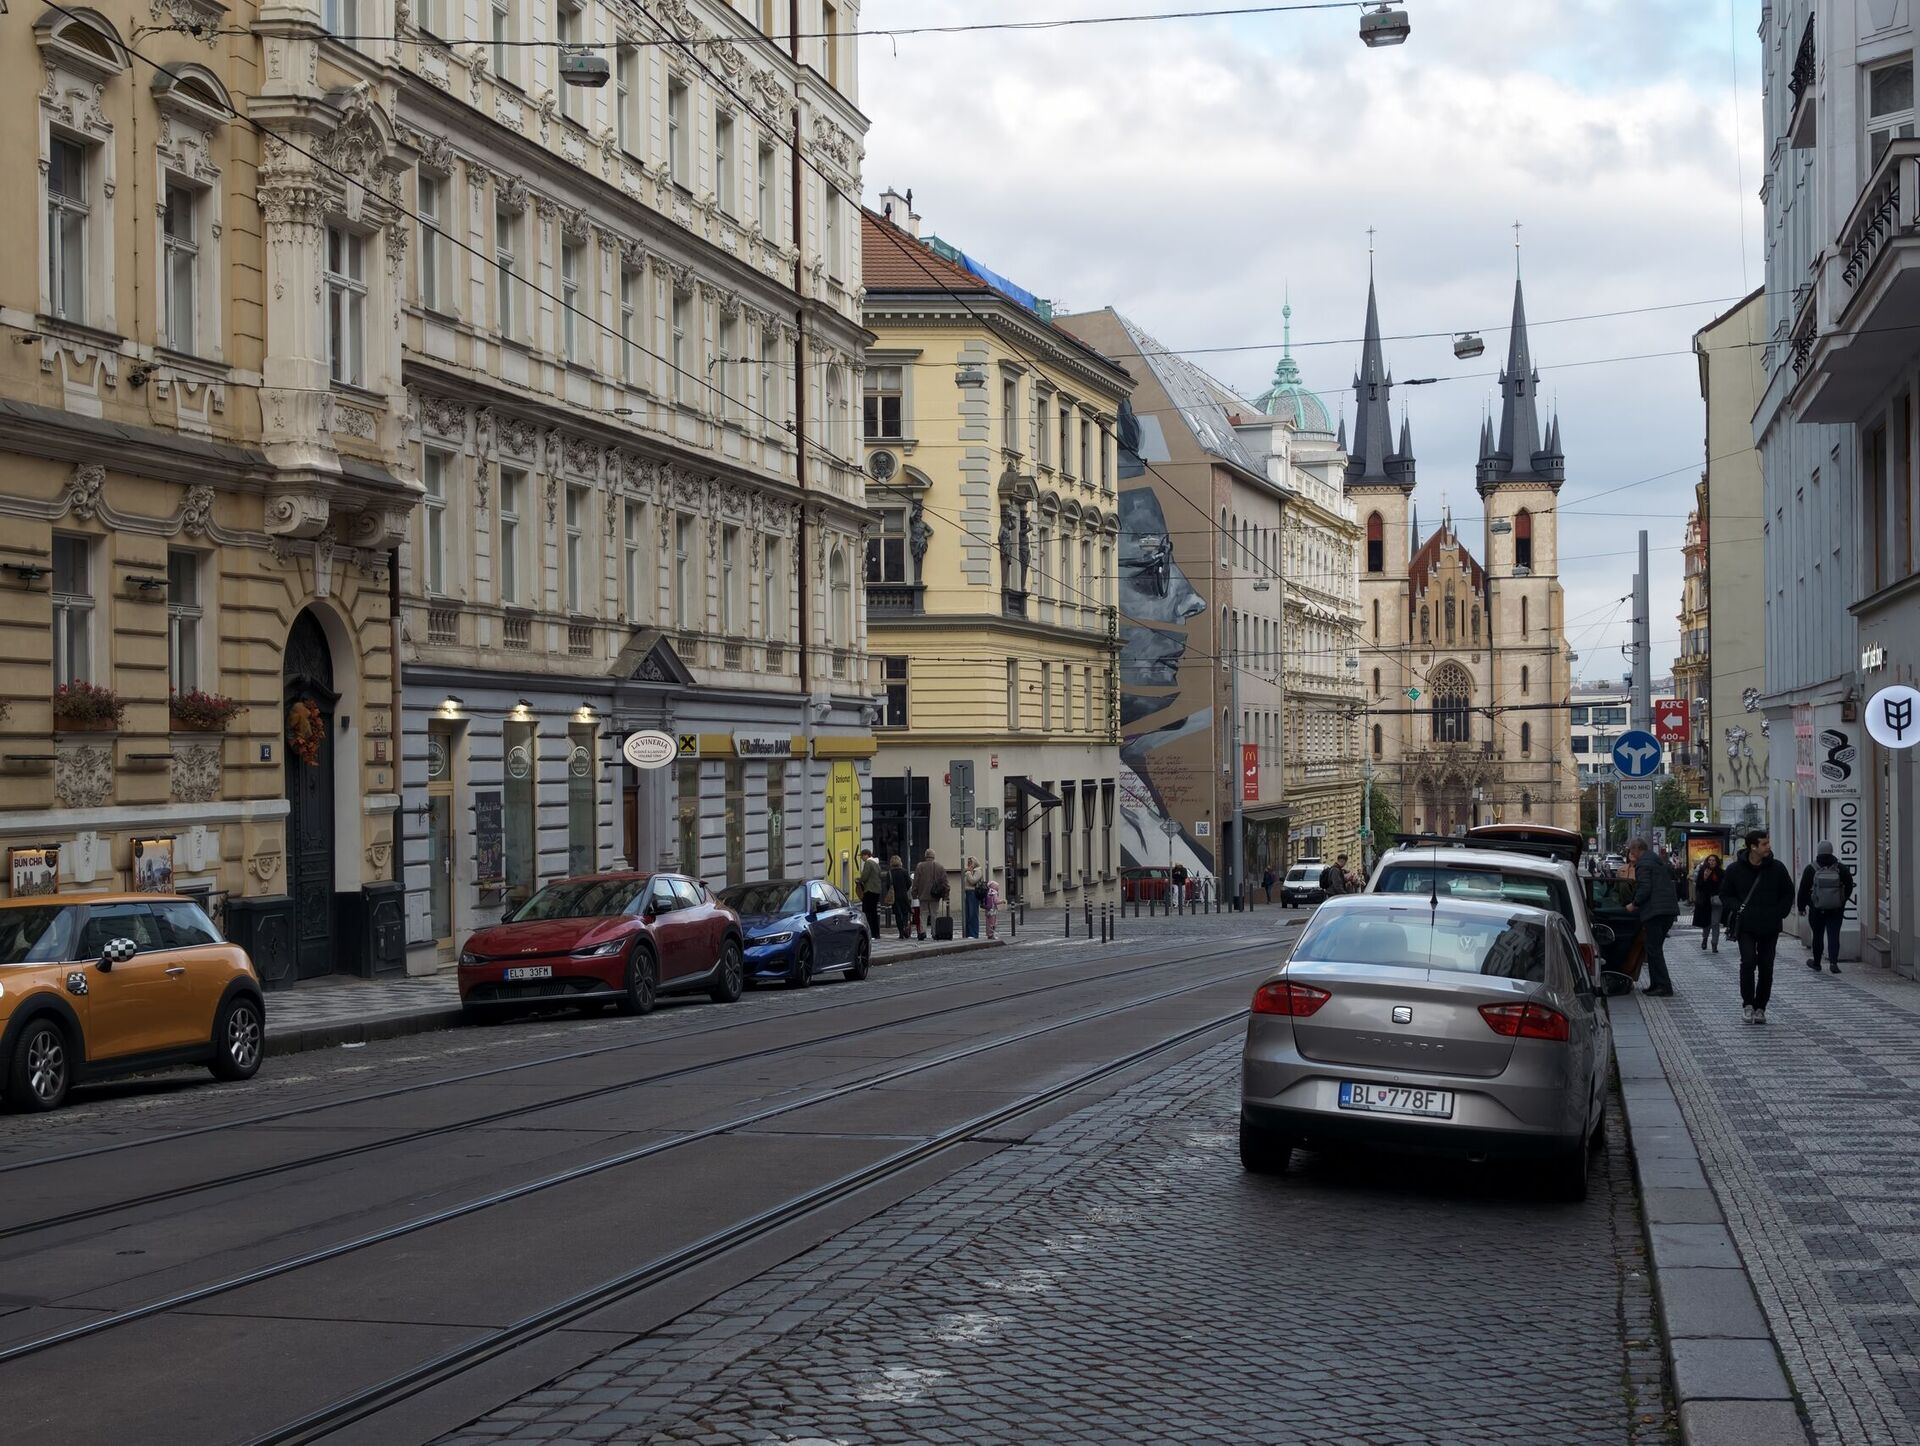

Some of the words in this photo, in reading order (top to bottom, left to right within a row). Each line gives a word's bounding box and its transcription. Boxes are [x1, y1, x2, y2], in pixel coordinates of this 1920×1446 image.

[1661, 701, 1684, 709] KFC
[631, 742, 641, 750] LA
[641, 738, 668, 749] VINERIA
[775, 740, 792, 754] BANK
[1840, 802, 1857, 921] ONIGIRZU
[510, 968, 524, 978] EL3
[530, 967, 549, 977] 33FM
[1352, 1085, 1376, 1105] BL
[1388, 1088, 1447, 1112] 778FI
